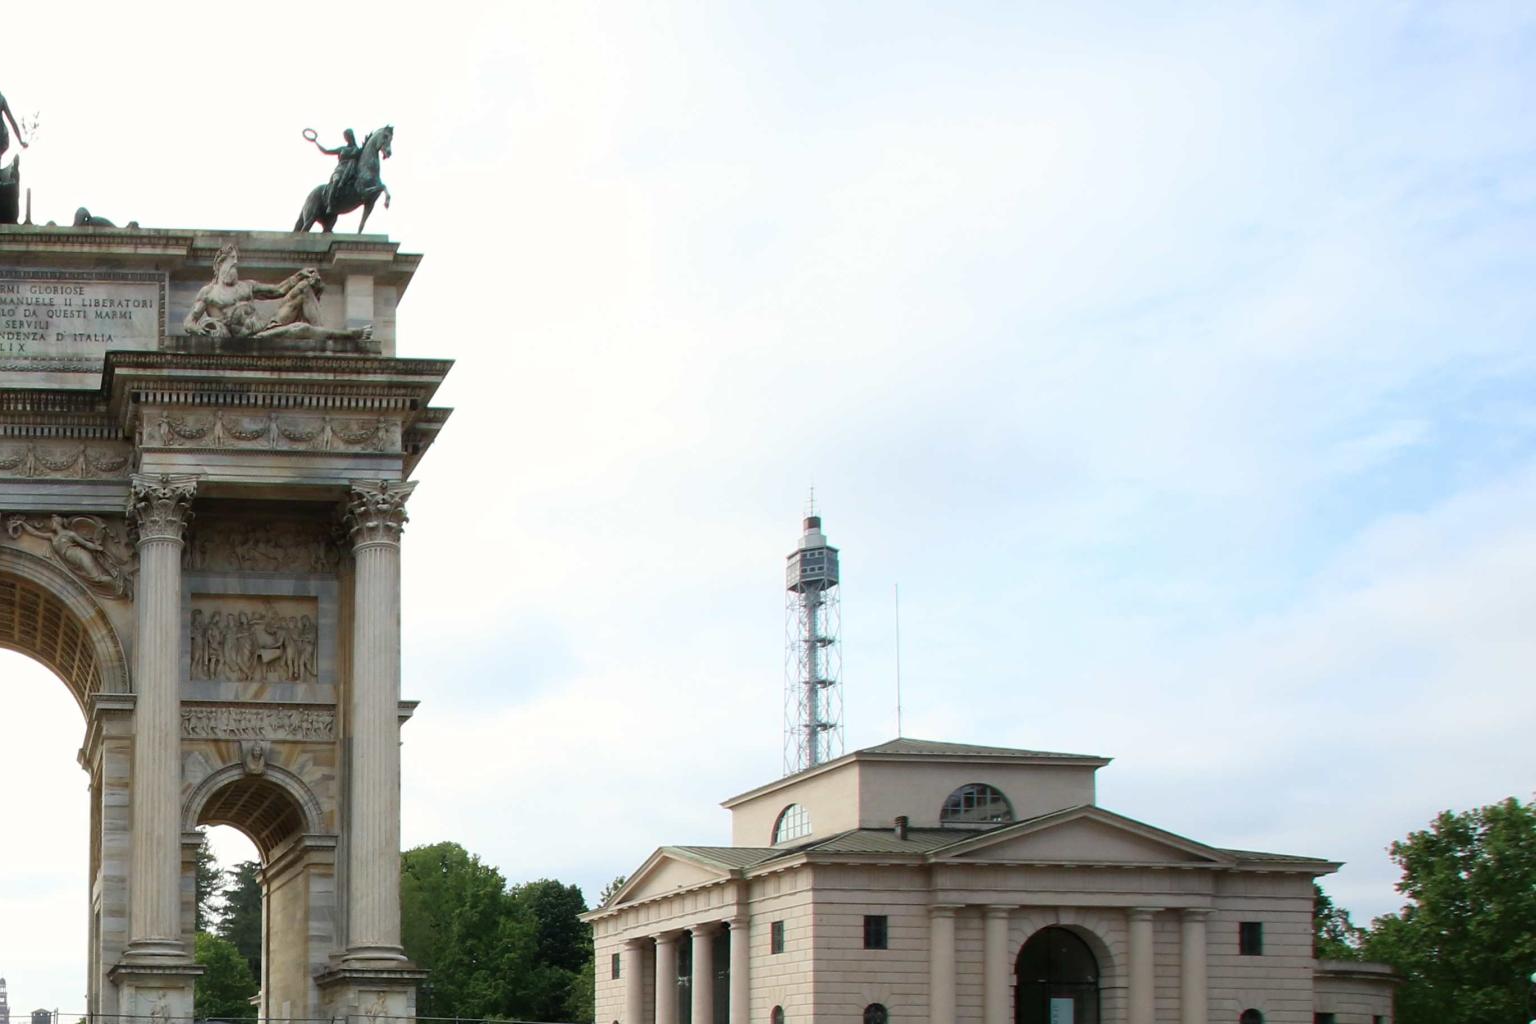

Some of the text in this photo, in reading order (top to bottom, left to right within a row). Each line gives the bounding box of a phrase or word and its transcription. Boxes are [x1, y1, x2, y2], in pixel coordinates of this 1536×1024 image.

[30, 286, 85, 296] GLORIOSE
[64, 298, 73, 307] II
[81, 299, 153, 309] LIBERATORI
[23, 309, 38, 318] DA
[47, 309, 87, 320] QUESTI
[95, 310, 132, 320] MARMI
[5, 320, 49, 330] SERVILI
[73, 333, 114, 343] ITALIA
